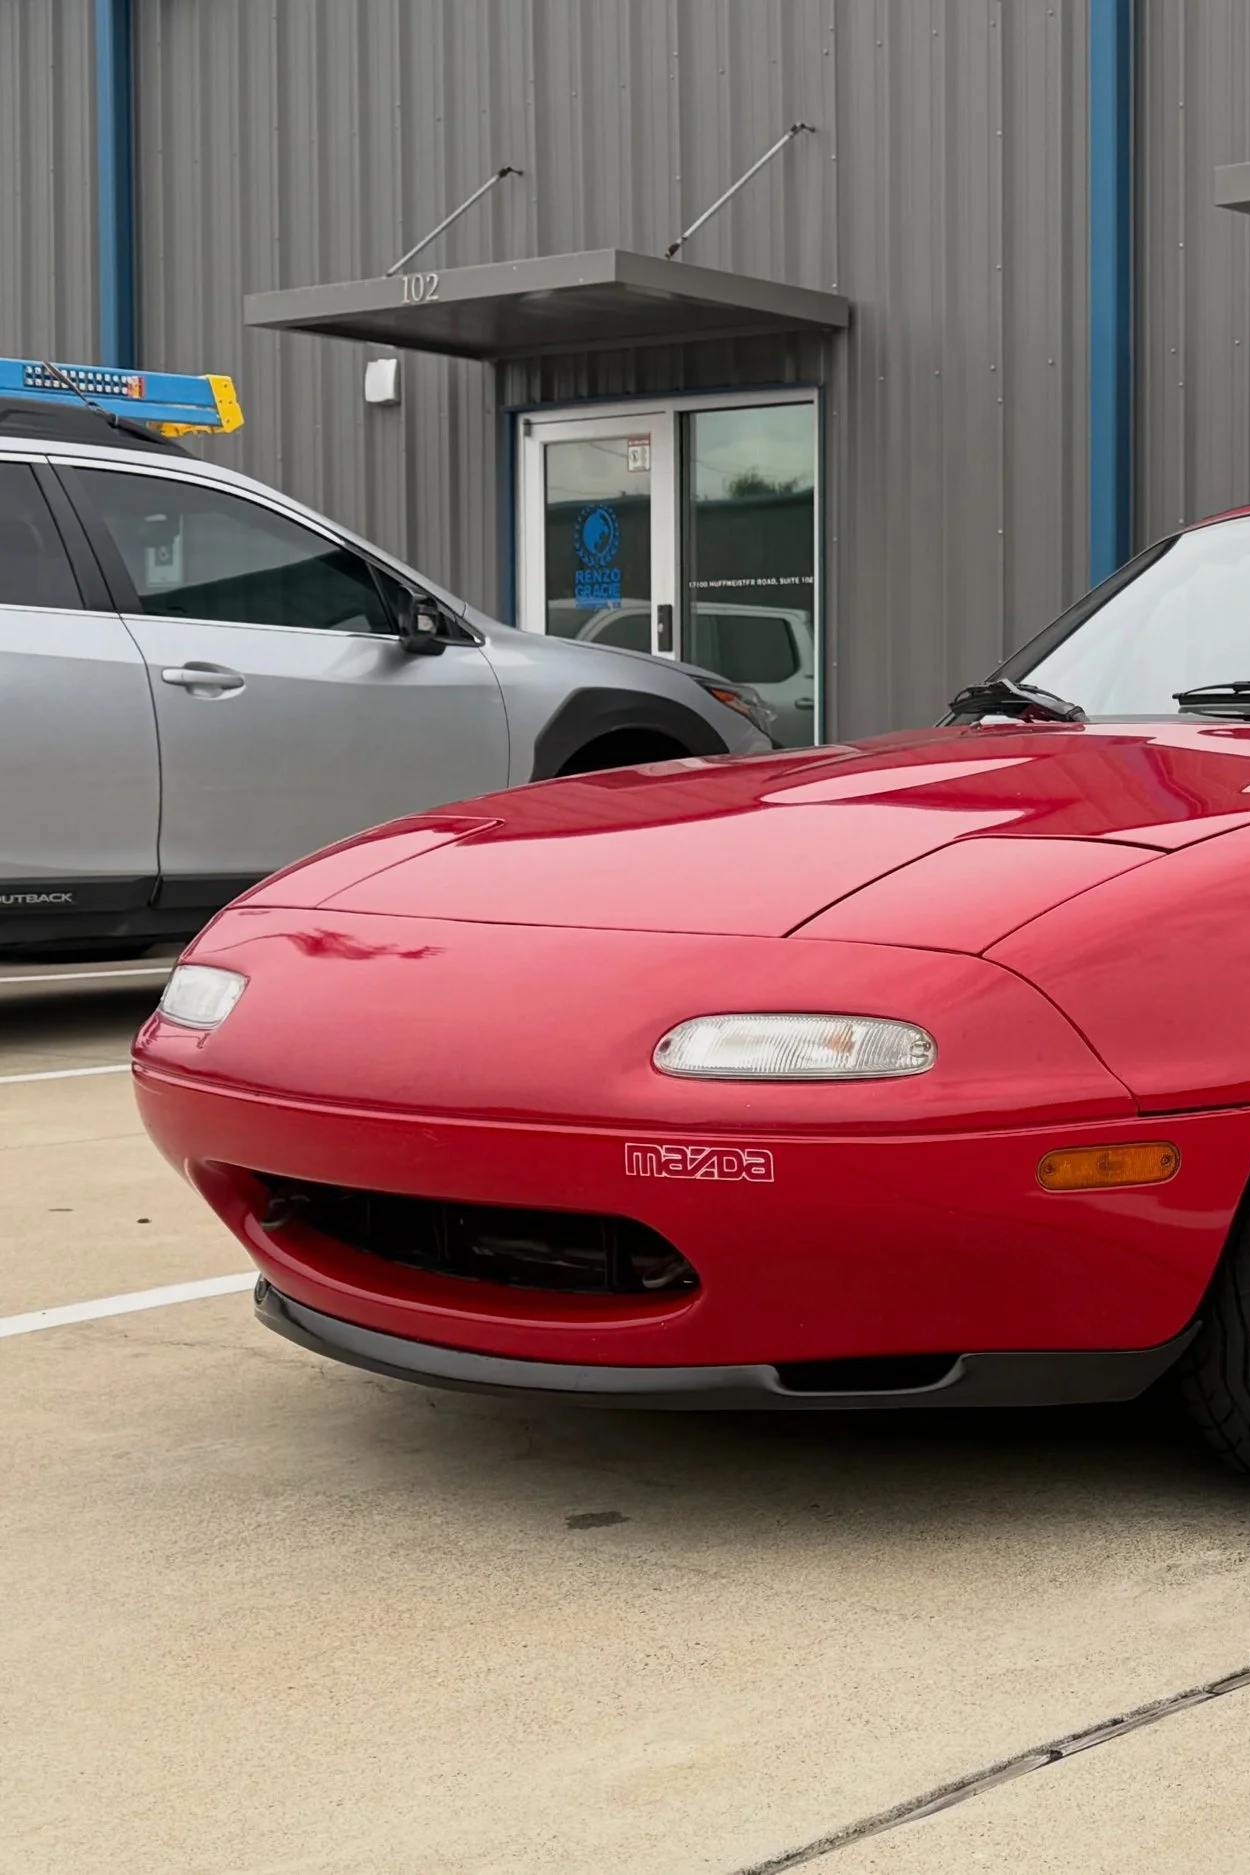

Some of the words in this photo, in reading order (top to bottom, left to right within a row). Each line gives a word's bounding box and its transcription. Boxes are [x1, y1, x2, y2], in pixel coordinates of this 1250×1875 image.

[402, 273, 439, 303] 102
[576, 568, 621, 584] RENZO
[779, 576, 799, 585] SUITE
[576, 584, 621, 598] GRACIE
[0, 892, 73, 904] UTBACK
[625, 1143, 774, 1182] mazda
